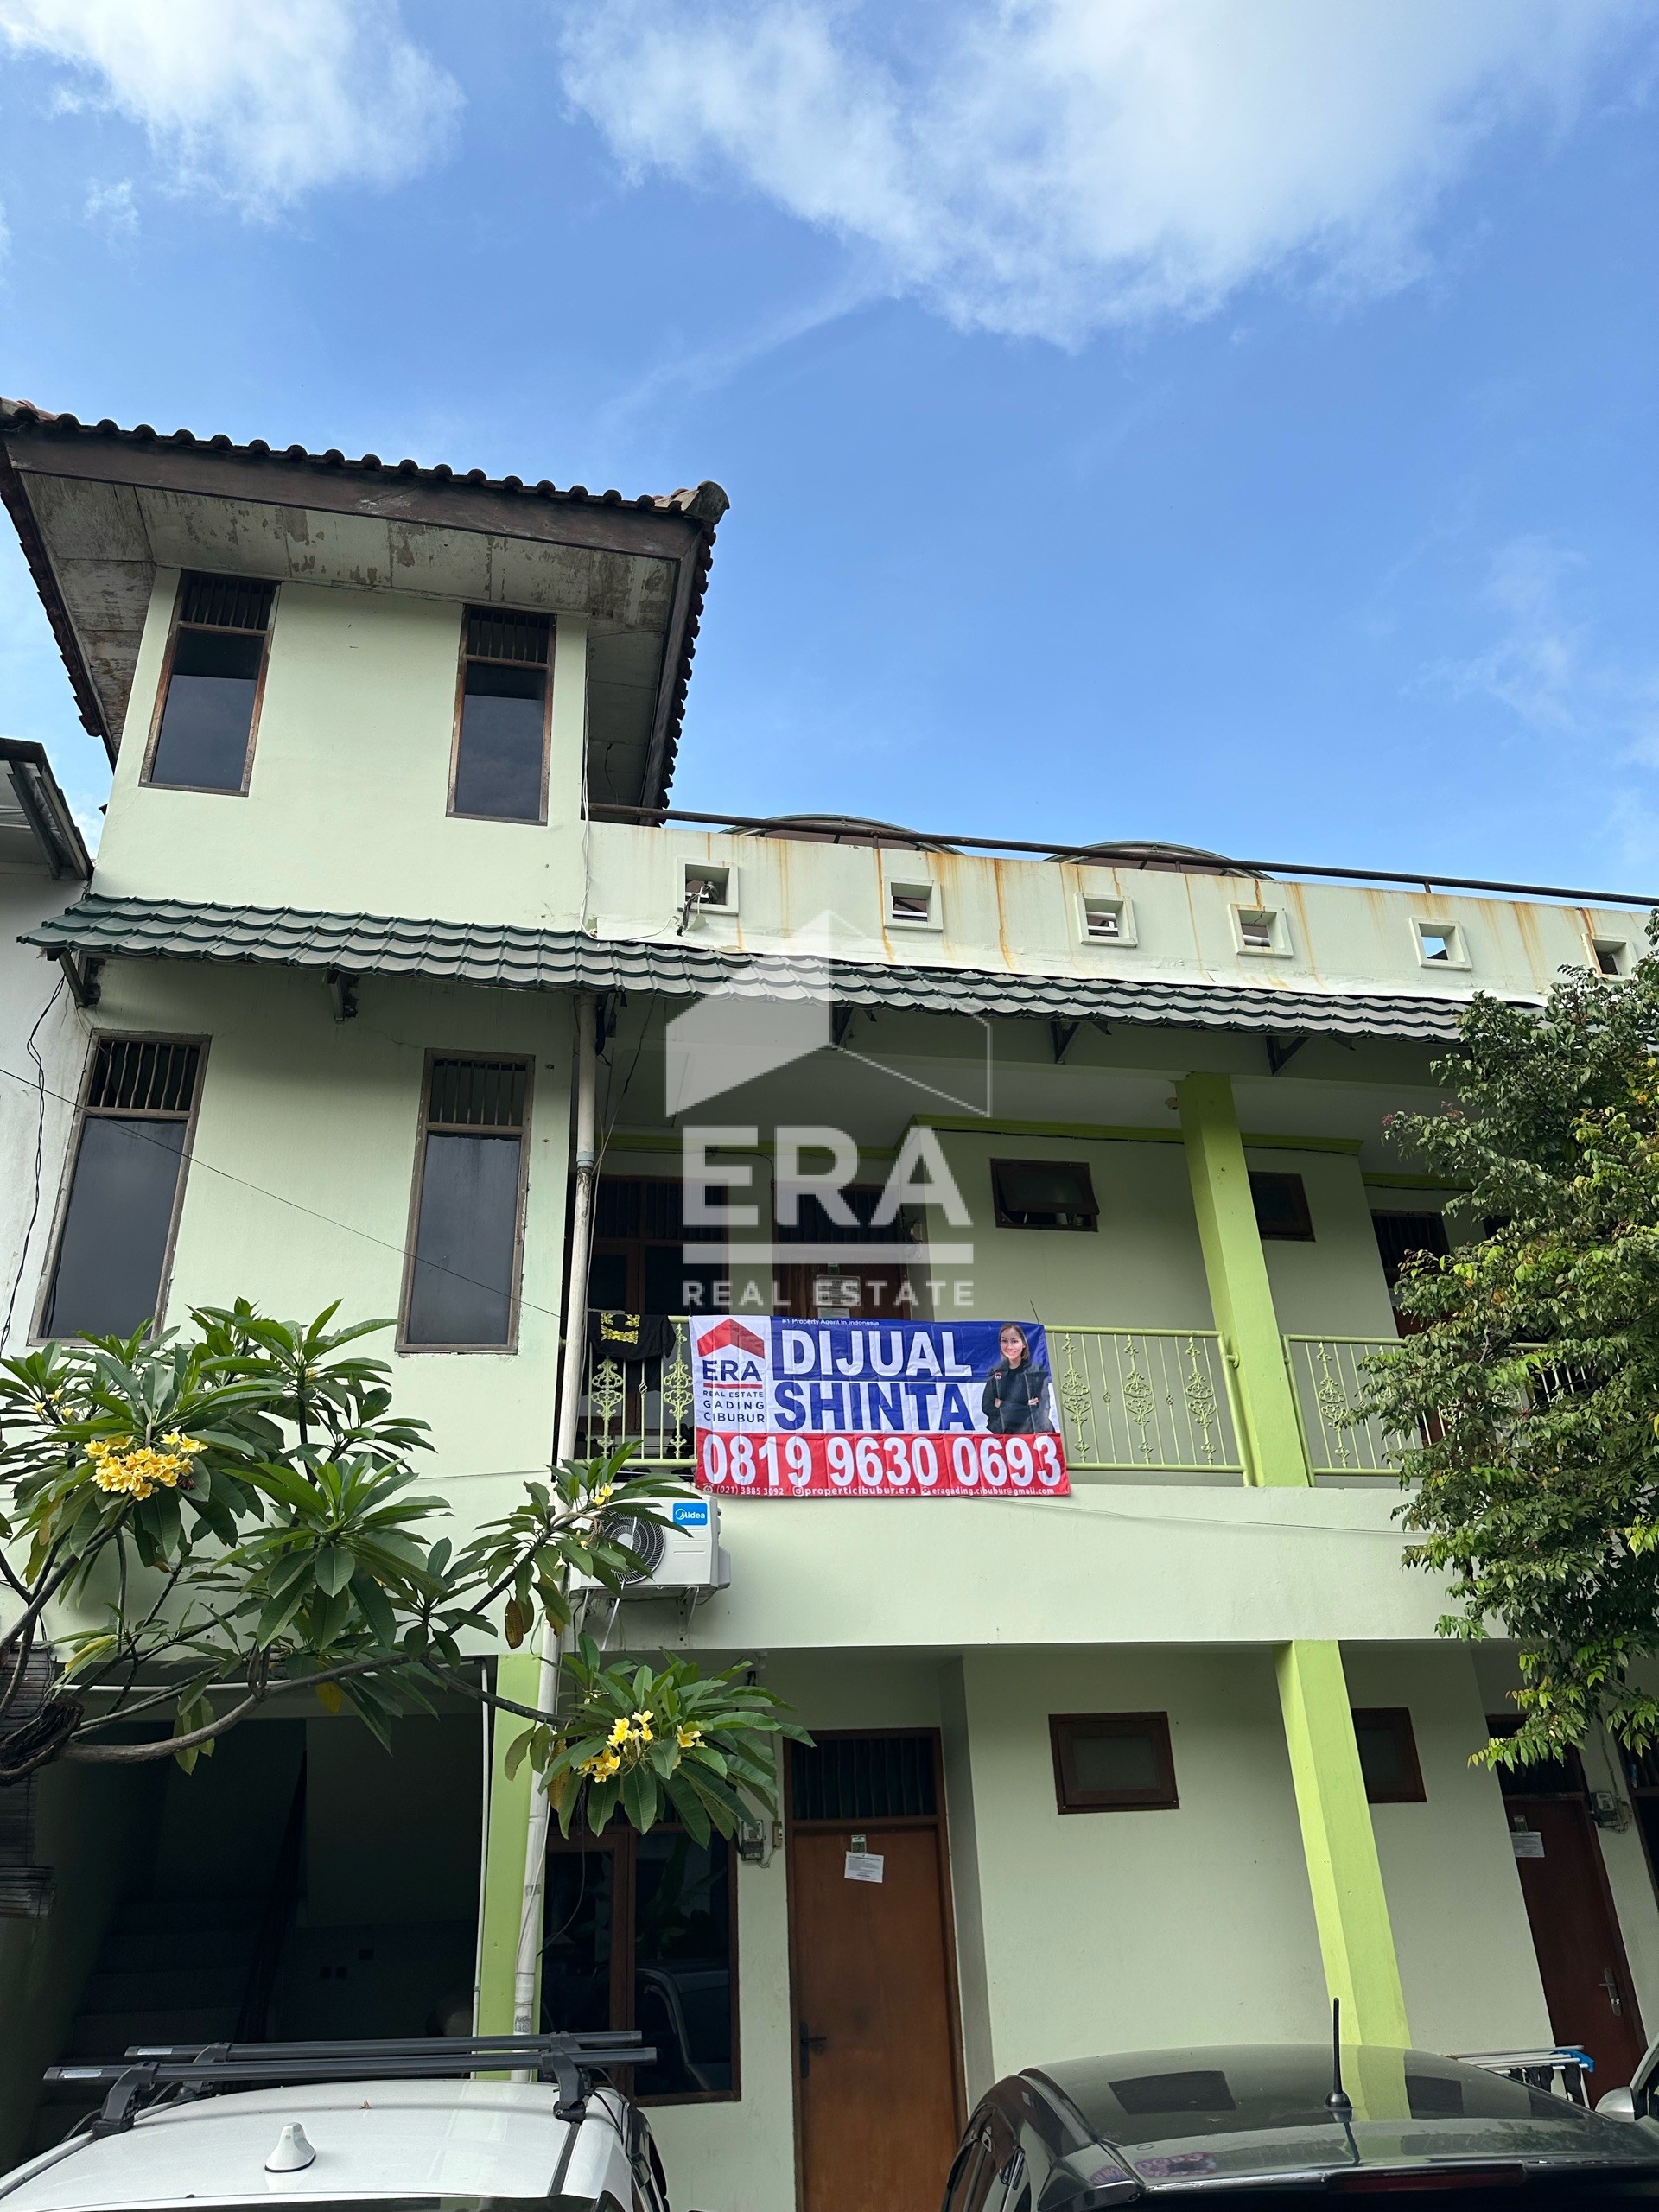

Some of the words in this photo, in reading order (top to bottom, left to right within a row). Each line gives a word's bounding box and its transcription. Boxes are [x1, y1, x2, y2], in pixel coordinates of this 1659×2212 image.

[783, 1330, 972, 1377] DIJUAL
[702, 1360, 762, 1381] ERA
[703, 1400, 764, 1410] GADING
[774, 1381, 976, 1431] SHINTA
[703, 1412, 765, 1423] CIBUBUR
[702, 1433, 812, 1486] 0819
[827, 1436, 937, 1487] 9630
[952, 1435, 1059, 1487] 0693
[716, 1485, 739, 1495] (021)
[741, 1486, 761, 1495] 3885
[764, 1487, 785, 1496] 3092
[804, 1485, 916, 1497] properticibubur.era
[931, 1486, 1055, 1496] eragading.cibubur@gmail.com
[675, 1508, 706, 1520] Midea
